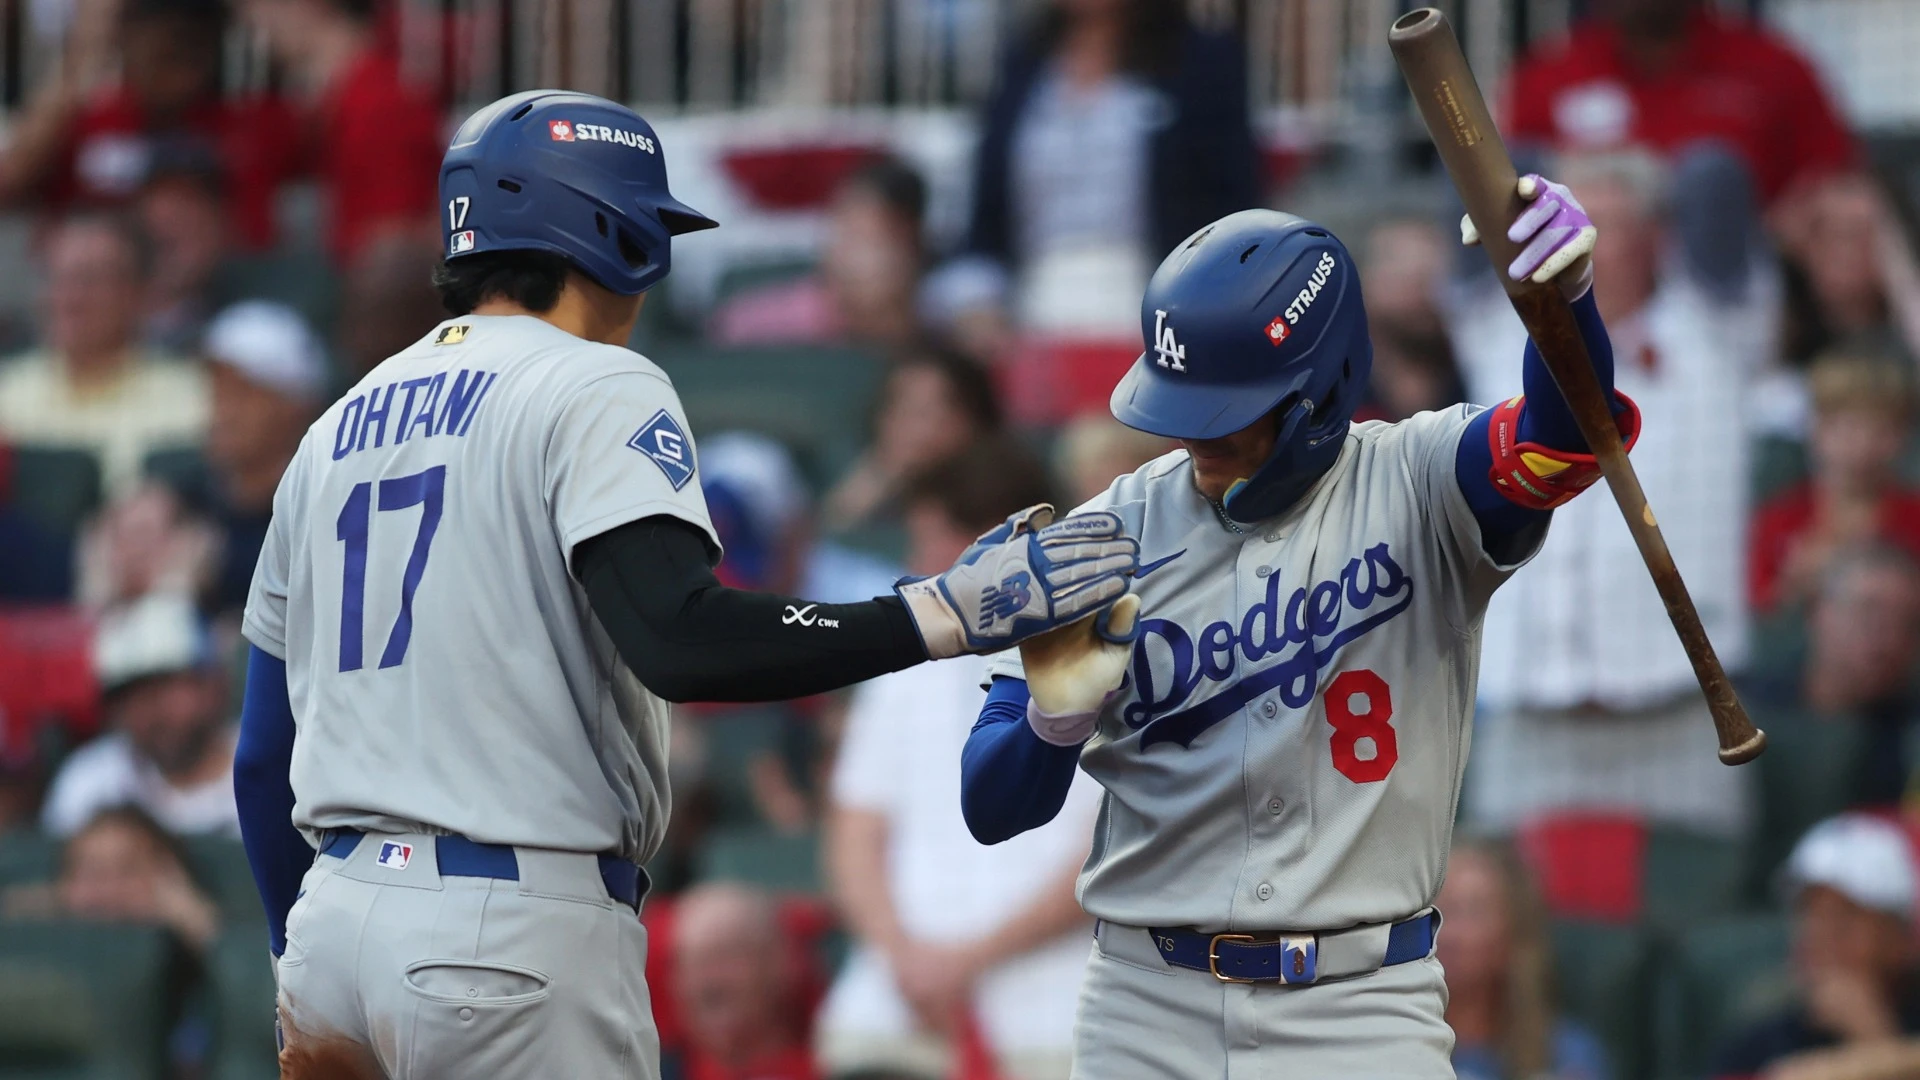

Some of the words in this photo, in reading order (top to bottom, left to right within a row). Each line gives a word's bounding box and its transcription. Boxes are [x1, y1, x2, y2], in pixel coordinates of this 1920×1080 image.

[575, 123, 655, 155] STRAUSS
[449, 196, 470, 231] 17
[1284, 251, 1336, 325] STRAUSS
[1154, 309, 1186, 372] LA
[332, 369, 498, 461] OHTANI
[654, 428, 682, 460] G
[337, 464, 446, 673] 17
[1124, 543, 1413, 730] Dodgers
[1323, 669, 1398, 784] 8
[1157, 935, 1175, 952] TS
